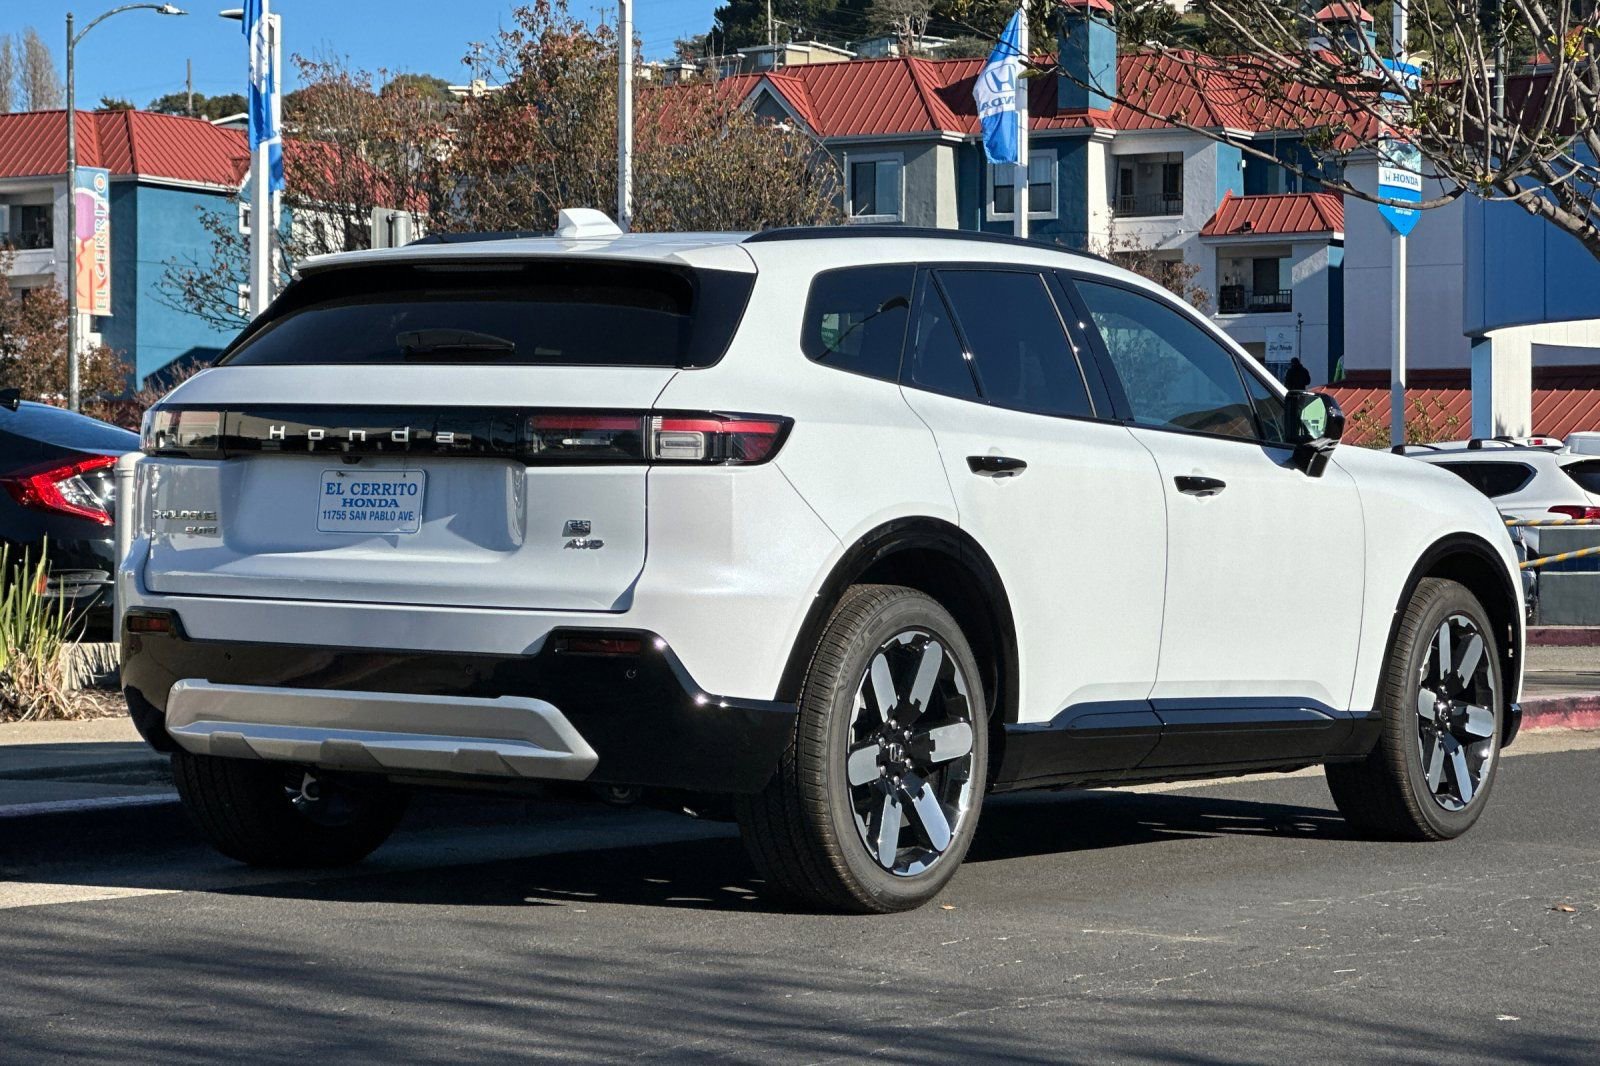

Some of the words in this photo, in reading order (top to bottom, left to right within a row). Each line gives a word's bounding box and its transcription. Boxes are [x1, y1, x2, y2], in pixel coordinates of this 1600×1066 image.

[1393, 173, 1419, 187] HONDA
[94, 173, 107, 280] CERRITO
[269, 424, 455, 443] Honda
[325, 482, 345, 495] EL
[350, 482, 418, 496] CERRITO
[341, 498, 400, 508] HONDA
[323, 510, 347, 520] 11755
[349, 510, 367, 521] SAN
[369, 510, 396, 521] PABLO
